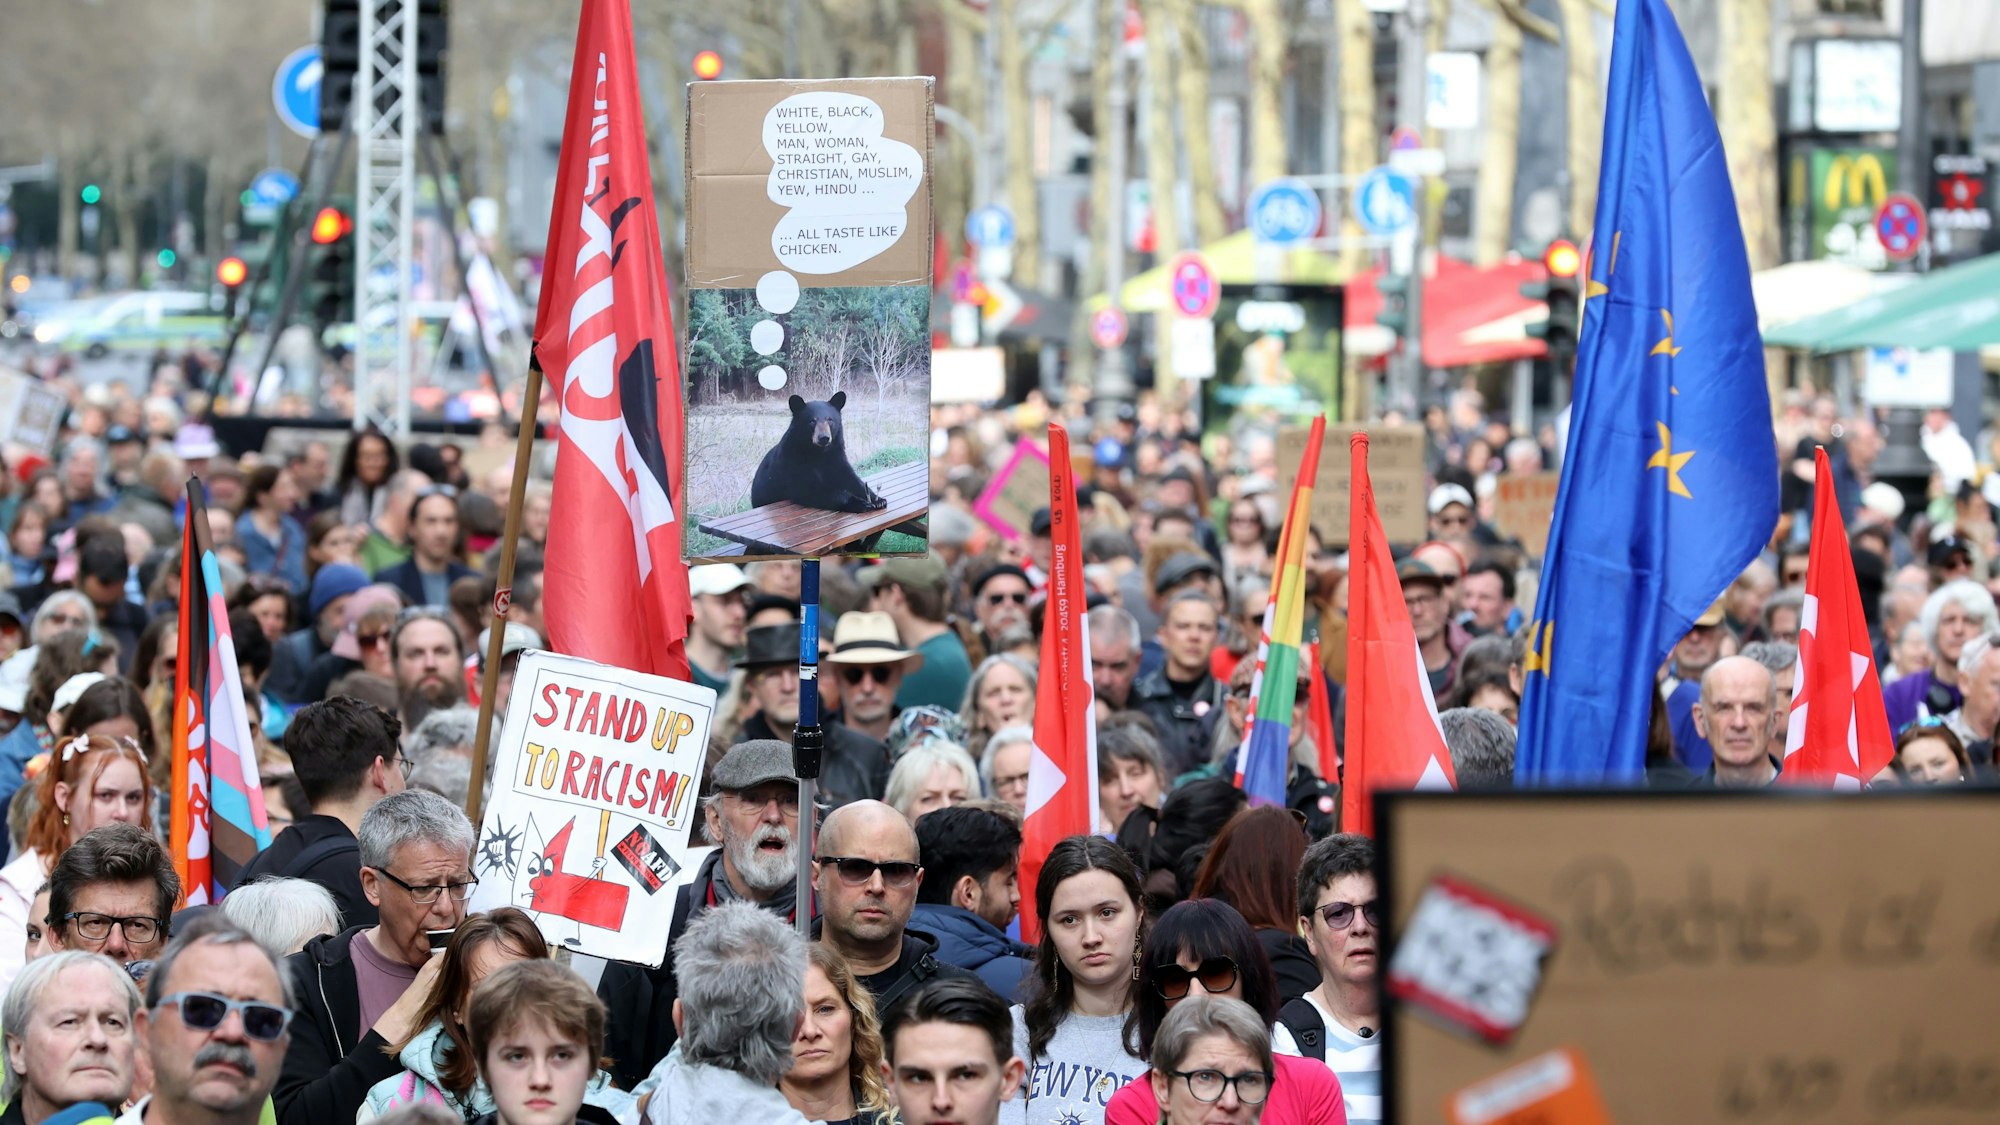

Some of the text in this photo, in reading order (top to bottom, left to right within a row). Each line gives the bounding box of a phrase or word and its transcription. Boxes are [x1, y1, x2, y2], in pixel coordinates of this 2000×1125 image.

[776, 106, 873, 118] WHITE, BLACK,
[776, 122, 832, 134] YELLOW,
[777, 137, 868, 150] MAN, WOMAN,
[777, 152, 881, 165] STRAIGHT, GAY,
[777, 167, 912, 180] CHRISTIAN, MUSLIM,
[778, 185, 810, 196] YEW,
[815, 184, 857, 195] HINDU
[798, 229, 820, 240] ALL
[824, 227, 864, 238] TASTE
[870, 226, 897, 237] LIKE
[779, 244, 842, 255] CHICKEN.
[1054, 544, 1067, 596] Hamburg
[1059, 599, 1069, 631] 20459
[533, 683, 694, 754] STAND UP
[525, 742, 691, 826] TO RACISM!
[1029, 1061, 1134, 1107] EW YO
